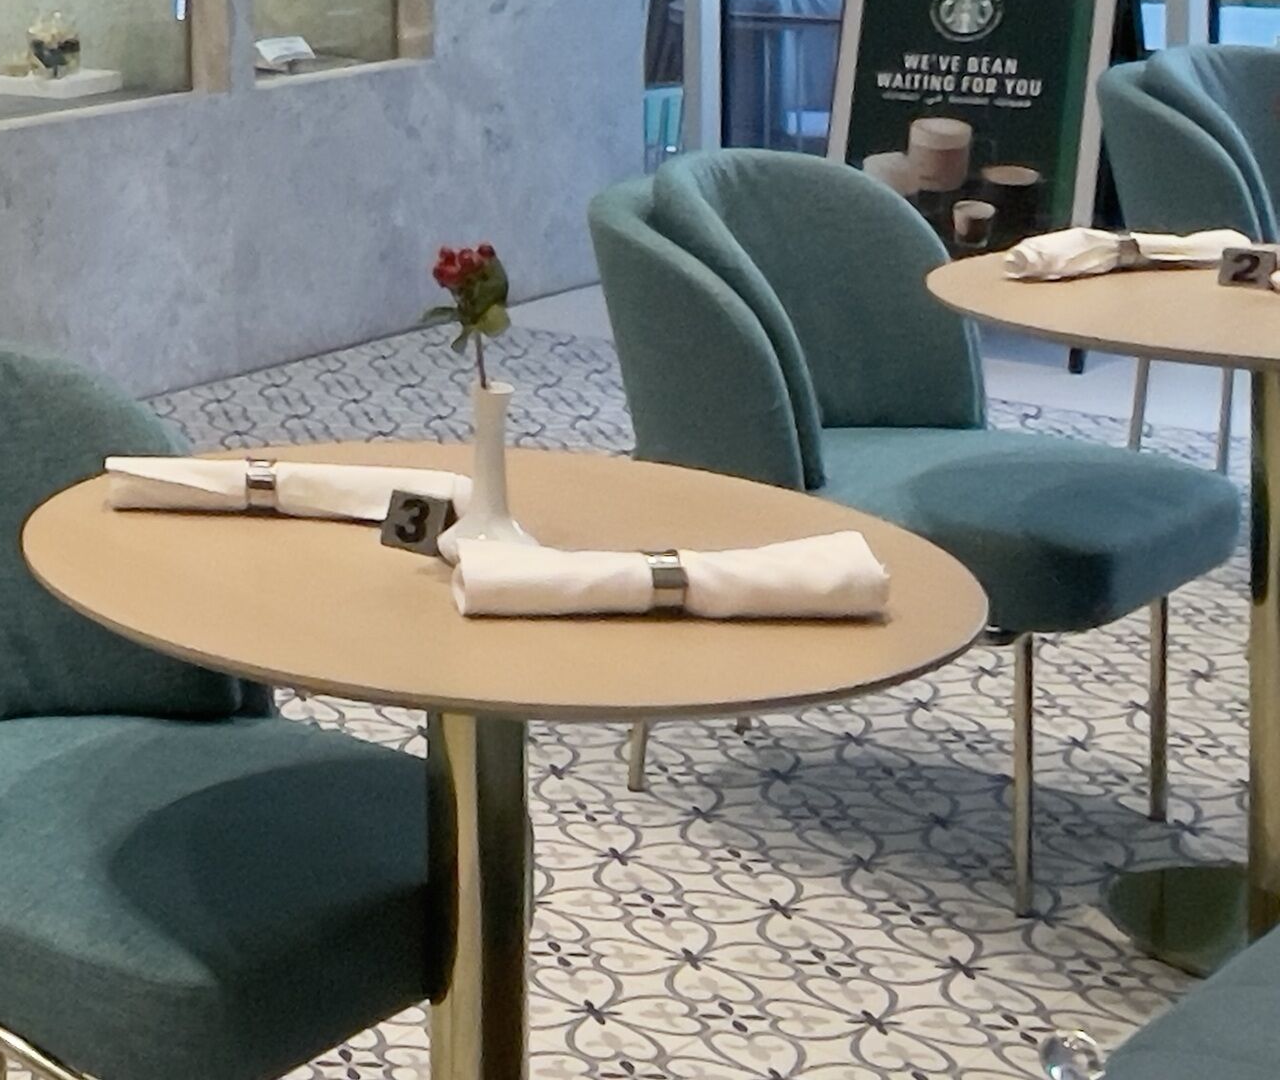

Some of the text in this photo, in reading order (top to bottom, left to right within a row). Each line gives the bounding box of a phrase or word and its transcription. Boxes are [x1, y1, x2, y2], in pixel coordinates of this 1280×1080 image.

[903, 53, 1019, 75] WE'VE BEAN
[876, 73, 1042, 97] WAITING FOR YOU
[1231, 253, 1261, 284] 2
[394, 499, 431, 544] 3
